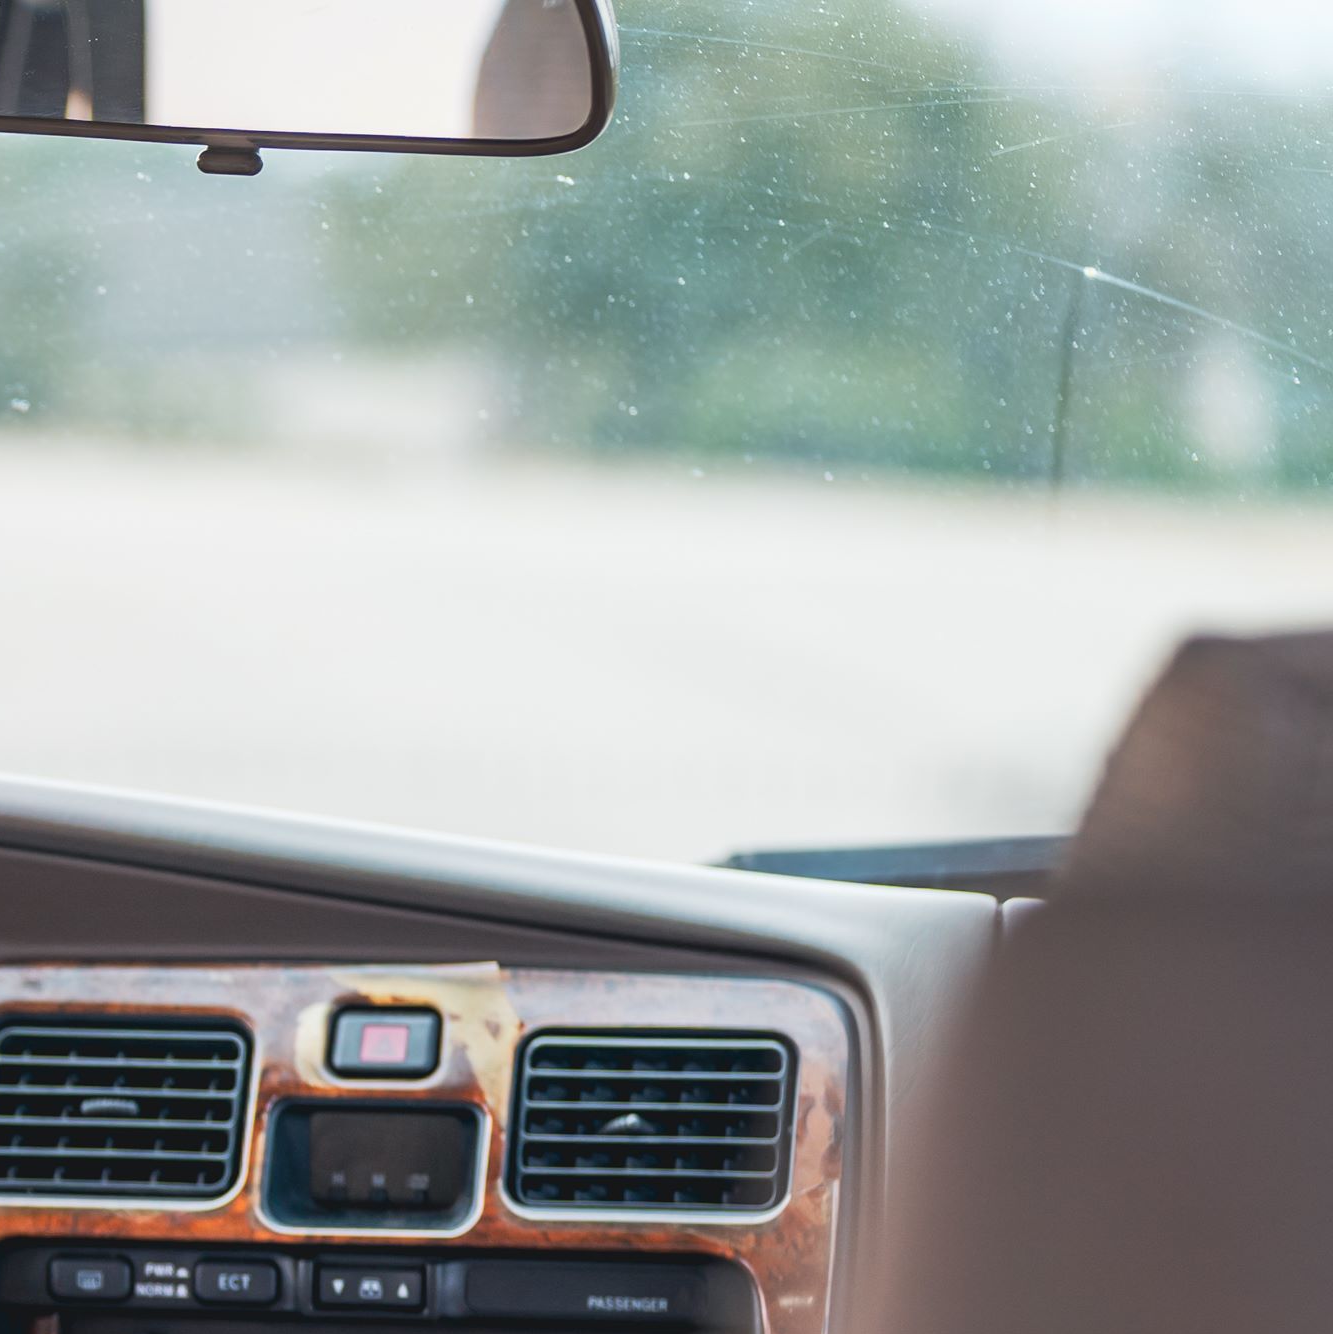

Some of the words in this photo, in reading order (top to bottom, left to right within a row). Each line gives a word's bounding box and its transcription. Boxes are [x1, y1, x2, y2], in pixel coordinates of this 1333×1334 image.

[144, 1262, 175, 1278] PWR
[135, 1281, 175, 1298] NORM
[218, 1273, 251, 1291] ECT
[586, 1294, 669, 1313] PASSENGER
